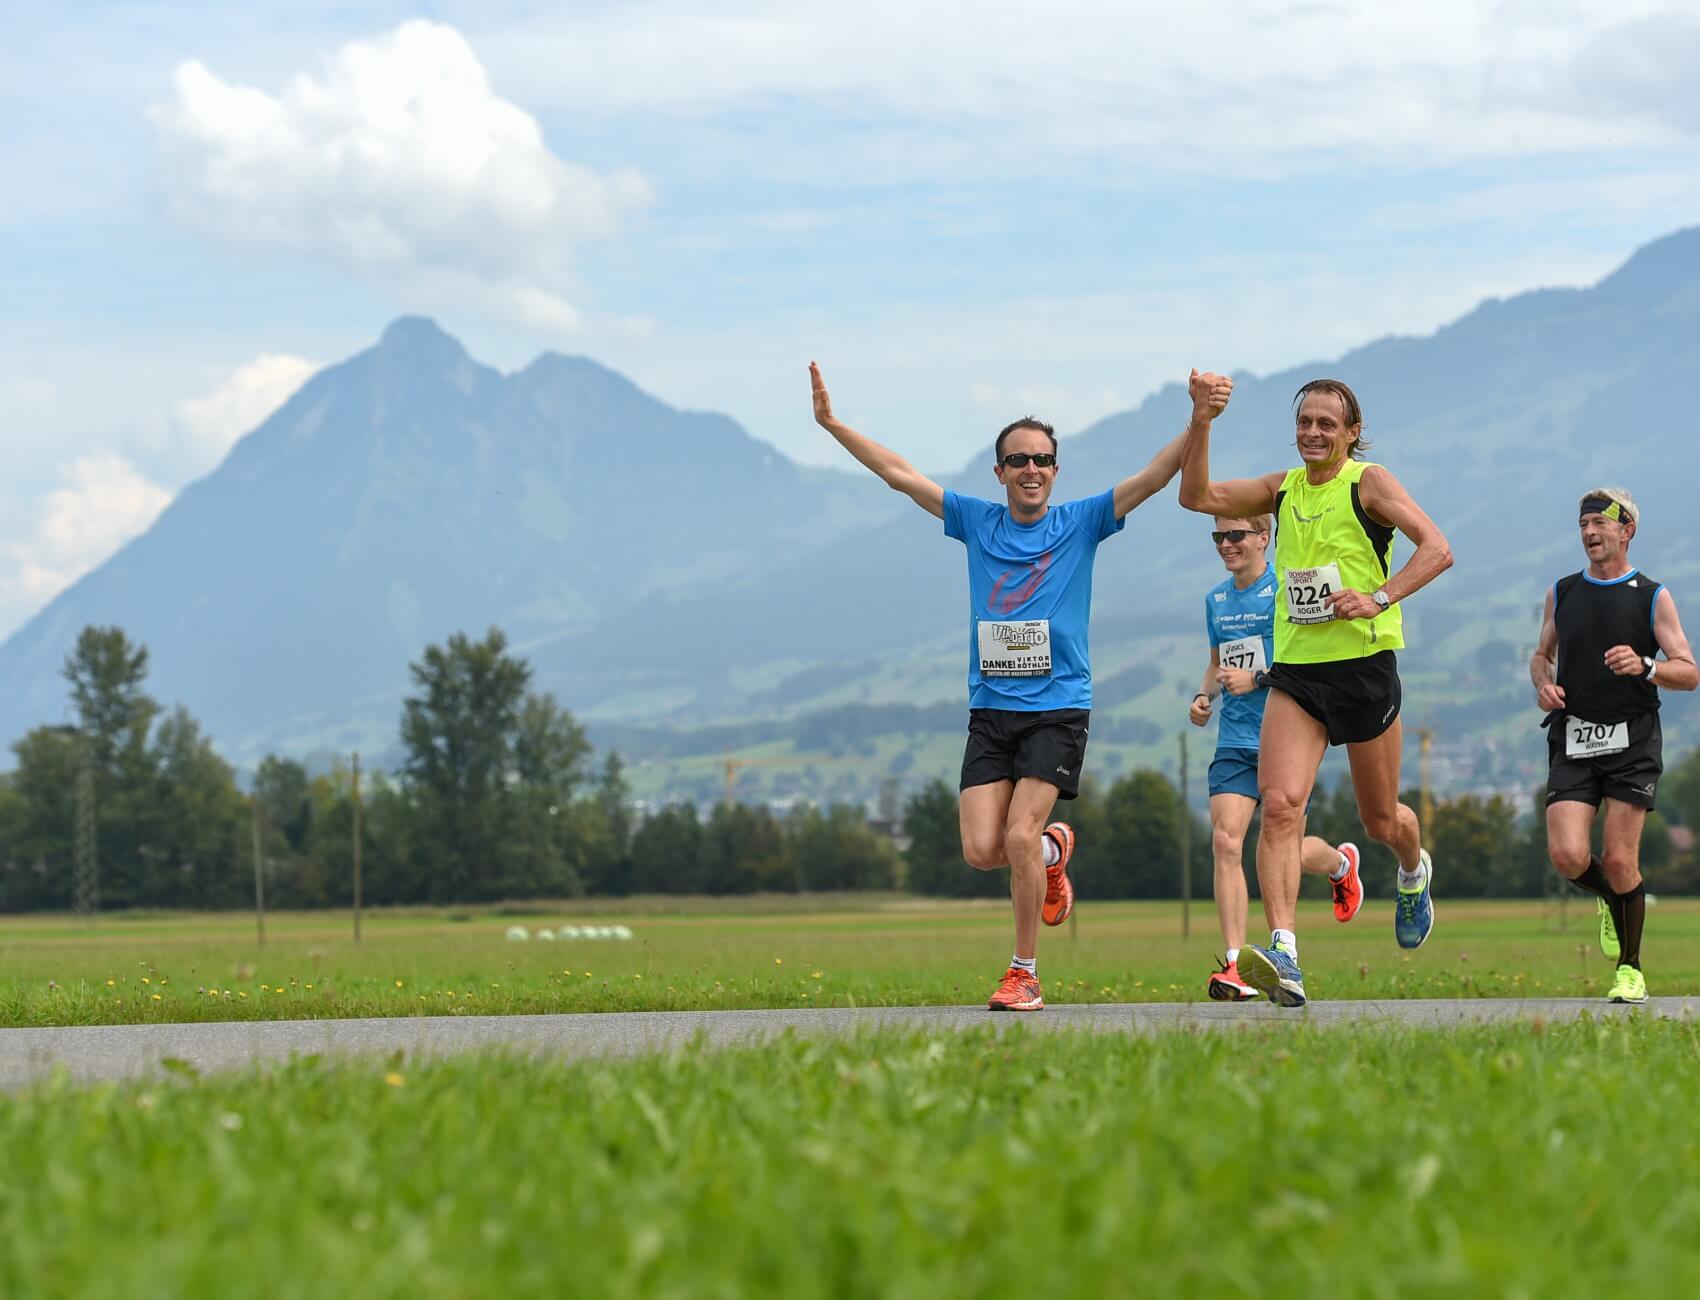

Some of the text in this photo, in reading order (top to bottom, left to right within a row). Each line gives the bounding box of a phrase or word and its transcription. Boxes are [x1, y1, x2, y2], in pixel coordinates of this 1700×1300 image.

[1288, 583, 1333, 606] 1224
[1297, 607, 1322, 615] ROGER
[982, 660, 1016, 669] DANKE!
[1223, 652, 1255, 669] 1577
[1574, 724, 1617, 744] 2707
